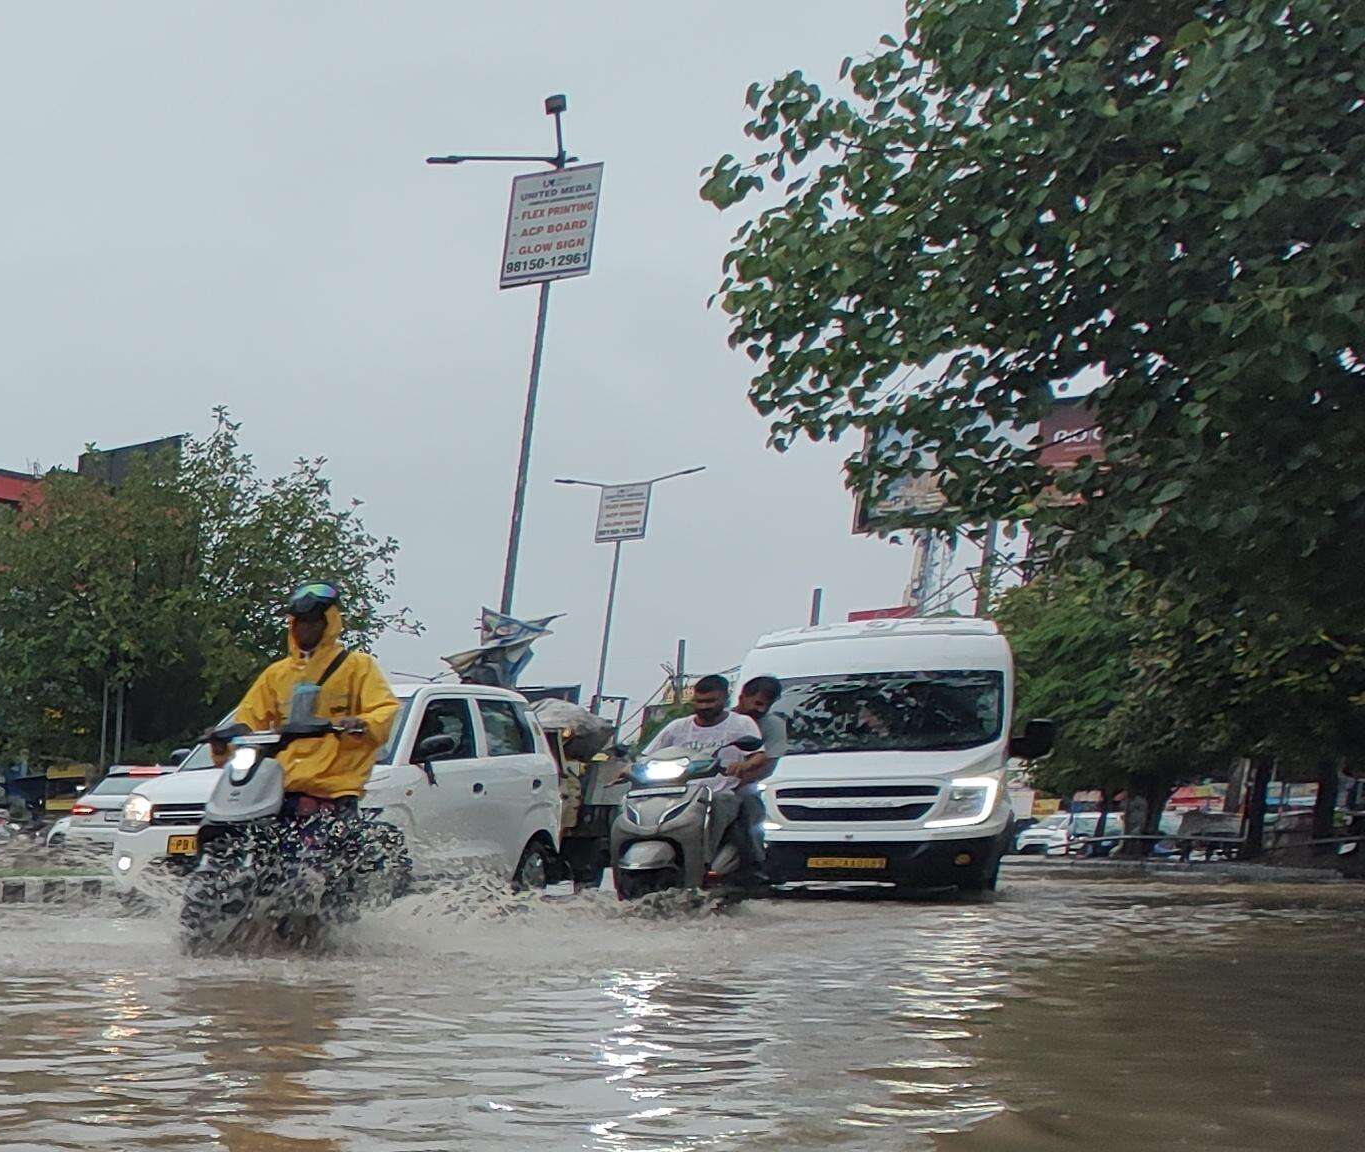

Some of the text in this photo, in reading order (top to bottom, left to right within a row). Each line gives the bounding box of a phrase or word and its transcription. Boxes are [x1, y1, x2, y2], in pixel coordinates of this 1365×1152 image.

[521, 188, 558, 202] UNITED
[561, 183, 593, 194] MEDIA
[521, 200, 594, 221] FLEX PRINTING
[520, 219, 588, 237] ACP BOARD
[518, 238, 586, 256] GLOW SIGN
